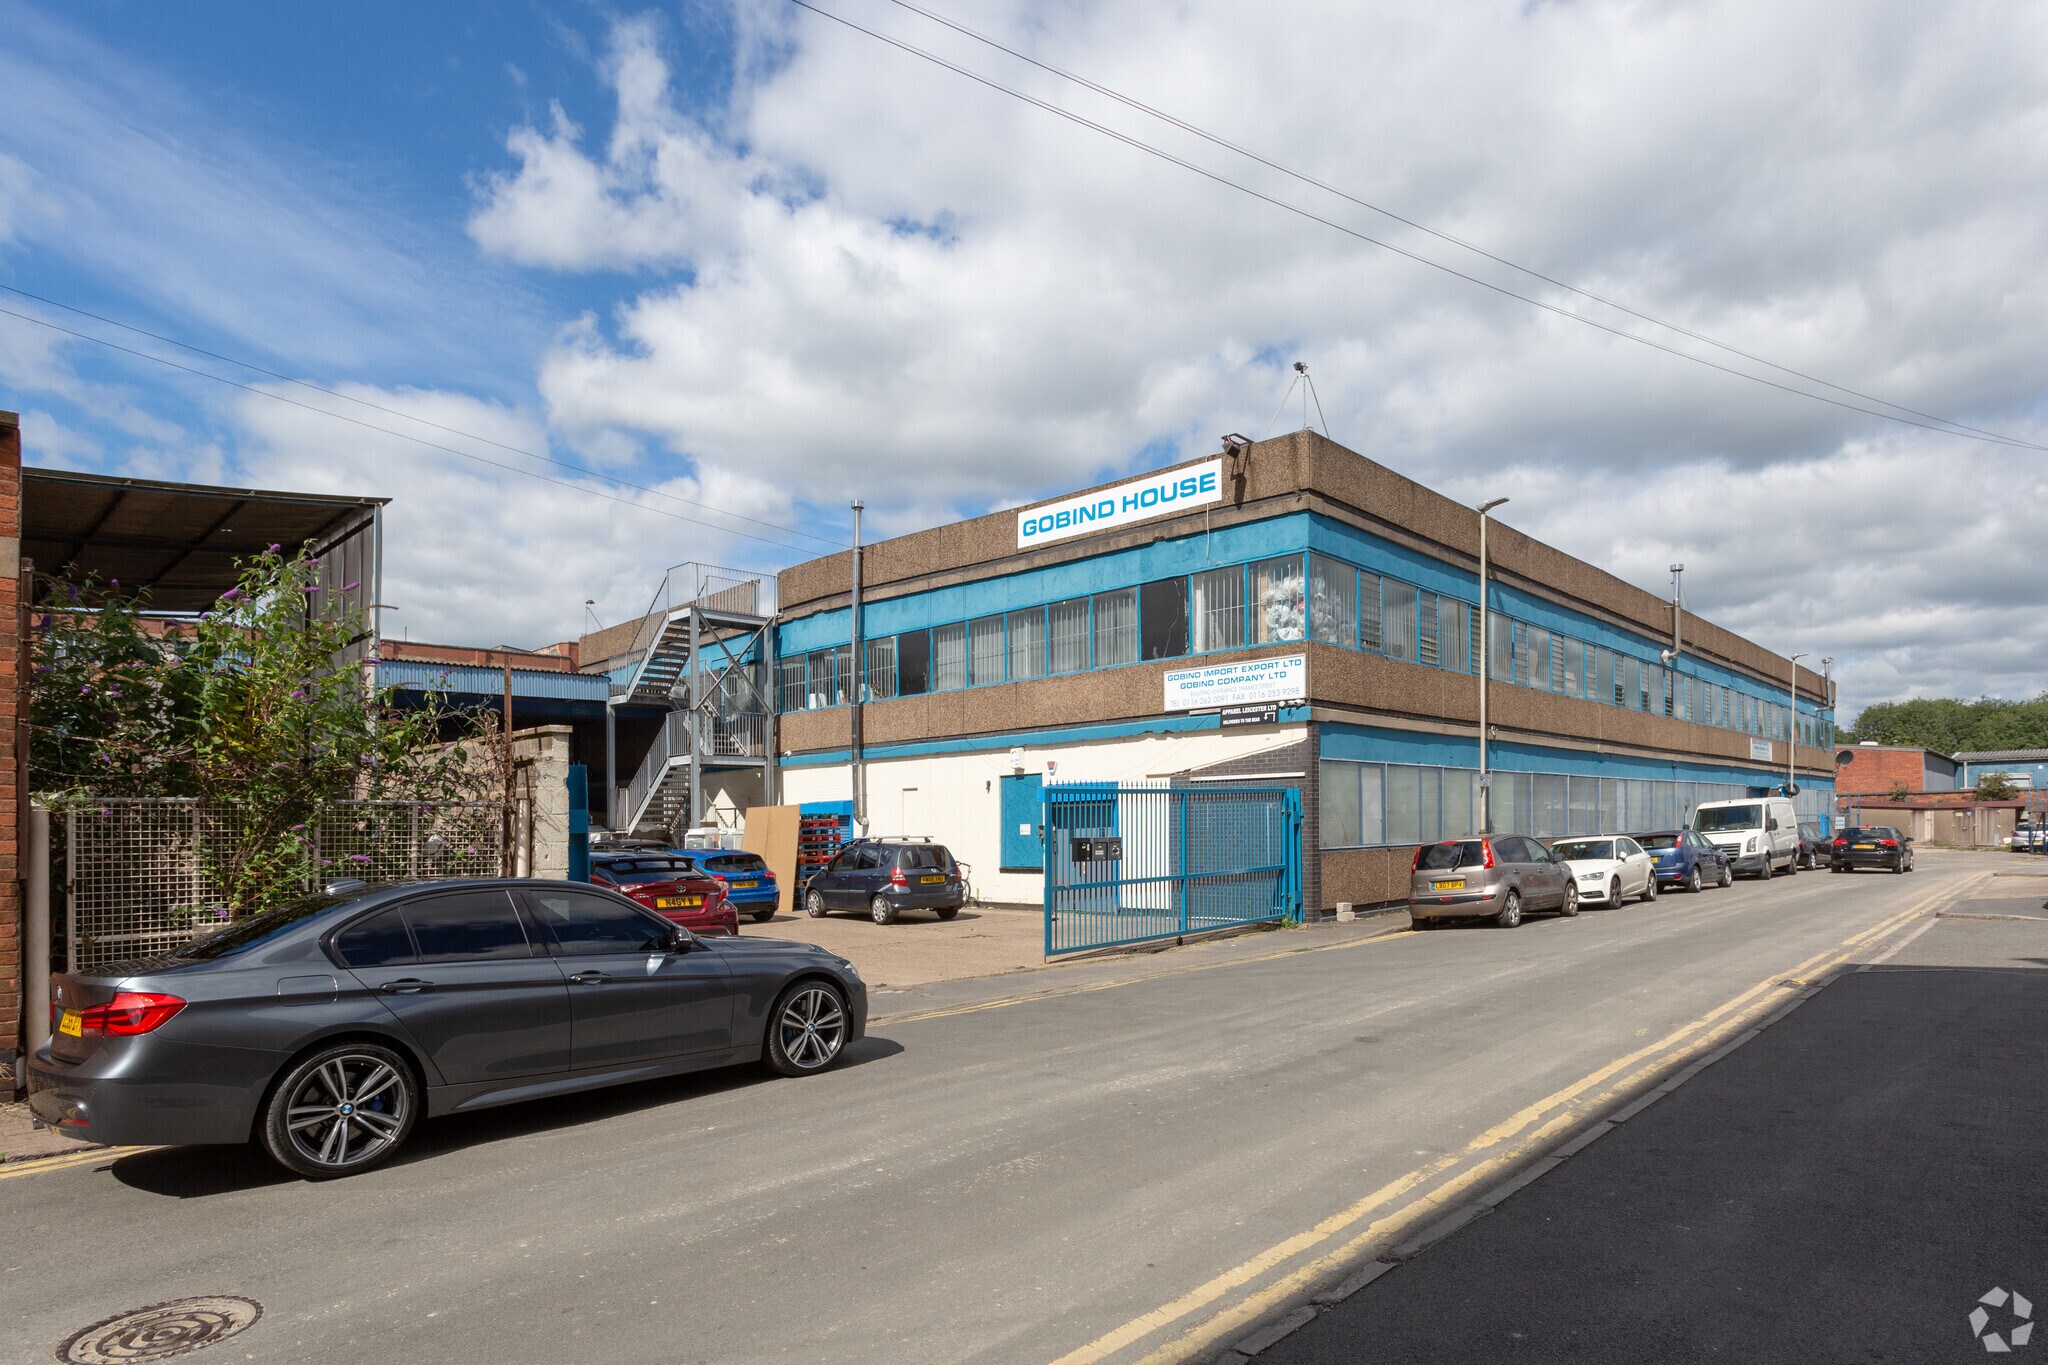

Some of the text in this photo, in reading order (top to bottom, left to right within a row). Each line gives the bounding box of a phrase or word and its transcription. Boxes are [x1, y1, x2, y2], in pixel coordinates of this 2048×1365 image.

[1023, 472, 1216, 537] GOBIND HOUSE
[1167, 658, 1302, 682] GOBIND IMPORT EXPORT LTD
[1180, 671, 1287, 690] GOBIND COMPANY LTD
[1170, 699, 1179, 708] TEL
[1182, 698, 1198, 706] 0116
[1200, 697, 1211, 705] 262
[1249, 691, 1265, 700] 0116
[1267, 689, 1281, 698] 253
[1282, 687, 1300, 696] 9298
[1242, 705, 1267, 713] LEICESTER
